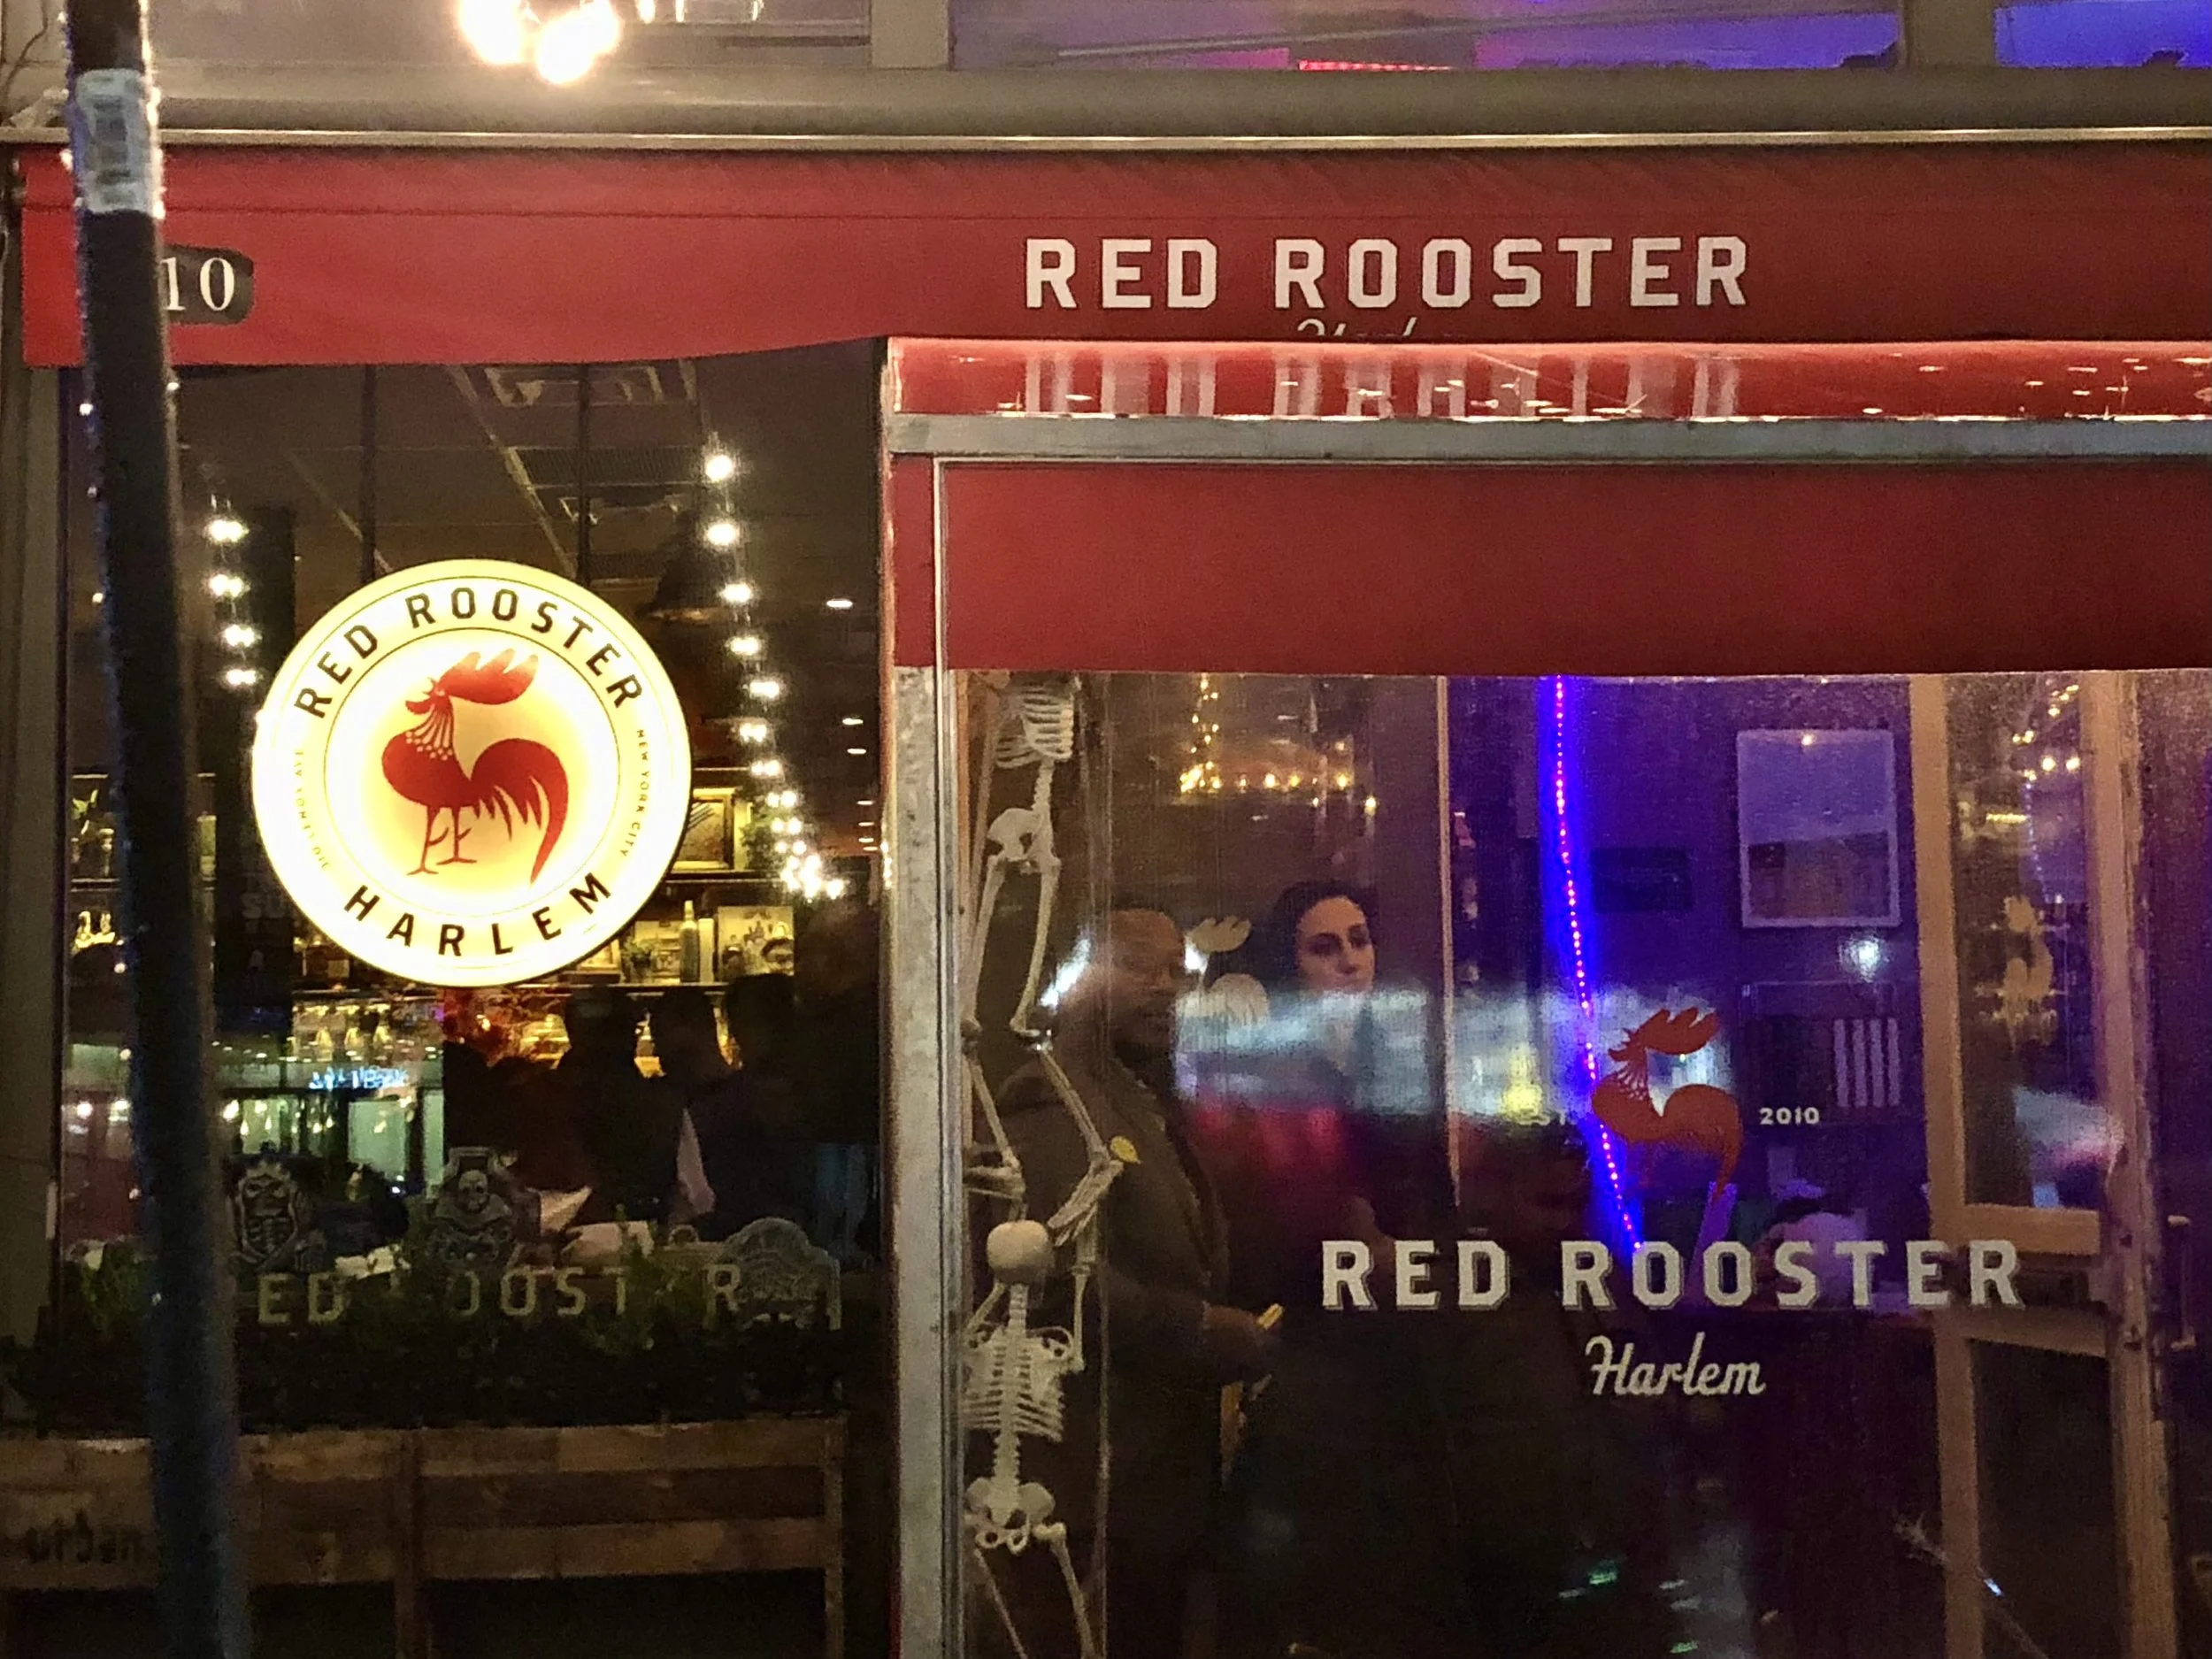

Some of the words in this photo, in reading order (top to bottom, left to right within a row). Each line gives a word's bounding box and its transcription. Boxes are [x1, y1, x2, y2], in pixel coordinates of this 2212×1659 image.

[1025, 238, 1218, 309] RED
[1274, 236, 1747, 309] ROOSTER
[294, 625, 378, 718] RED
[404, 588, 643, 708] ROOSTER
[636, 729, 649, 762] NEW
[635, 771, 649, 812] YORK
[619, 822, 641, 857] CITY
[343, 872, 611, 956] HARLEM
[1759, 1106, 1820, 1125] 2010
[1322, 1240, 1511, 1311] RED
[1560, 1240, 2025, 1311] ROOSTER
[1585, 1332, 1767, 1395] Harlem
